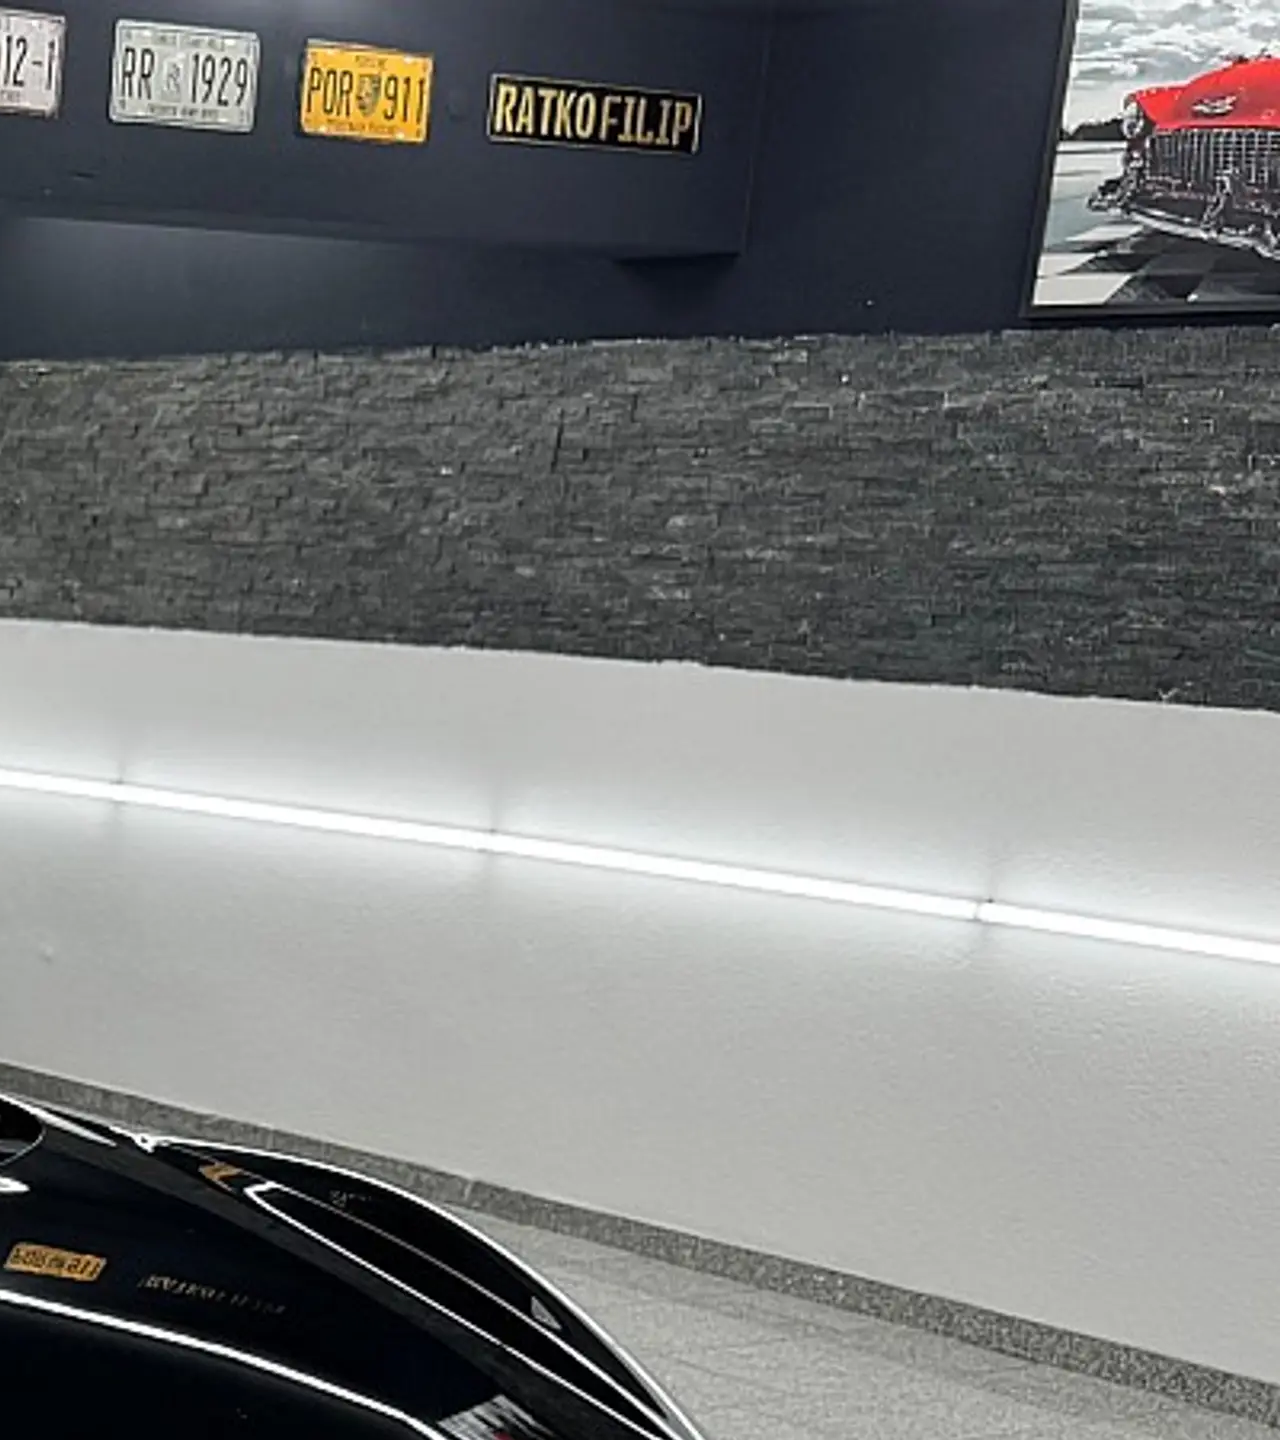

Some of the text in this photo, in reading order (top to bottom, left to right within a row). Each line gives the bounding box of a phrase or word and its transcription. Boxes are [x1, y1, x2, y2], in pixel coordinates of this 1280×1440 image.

[121, 47, 248, 107] RR 1929
[306, 67, 426, 125] POR 911
